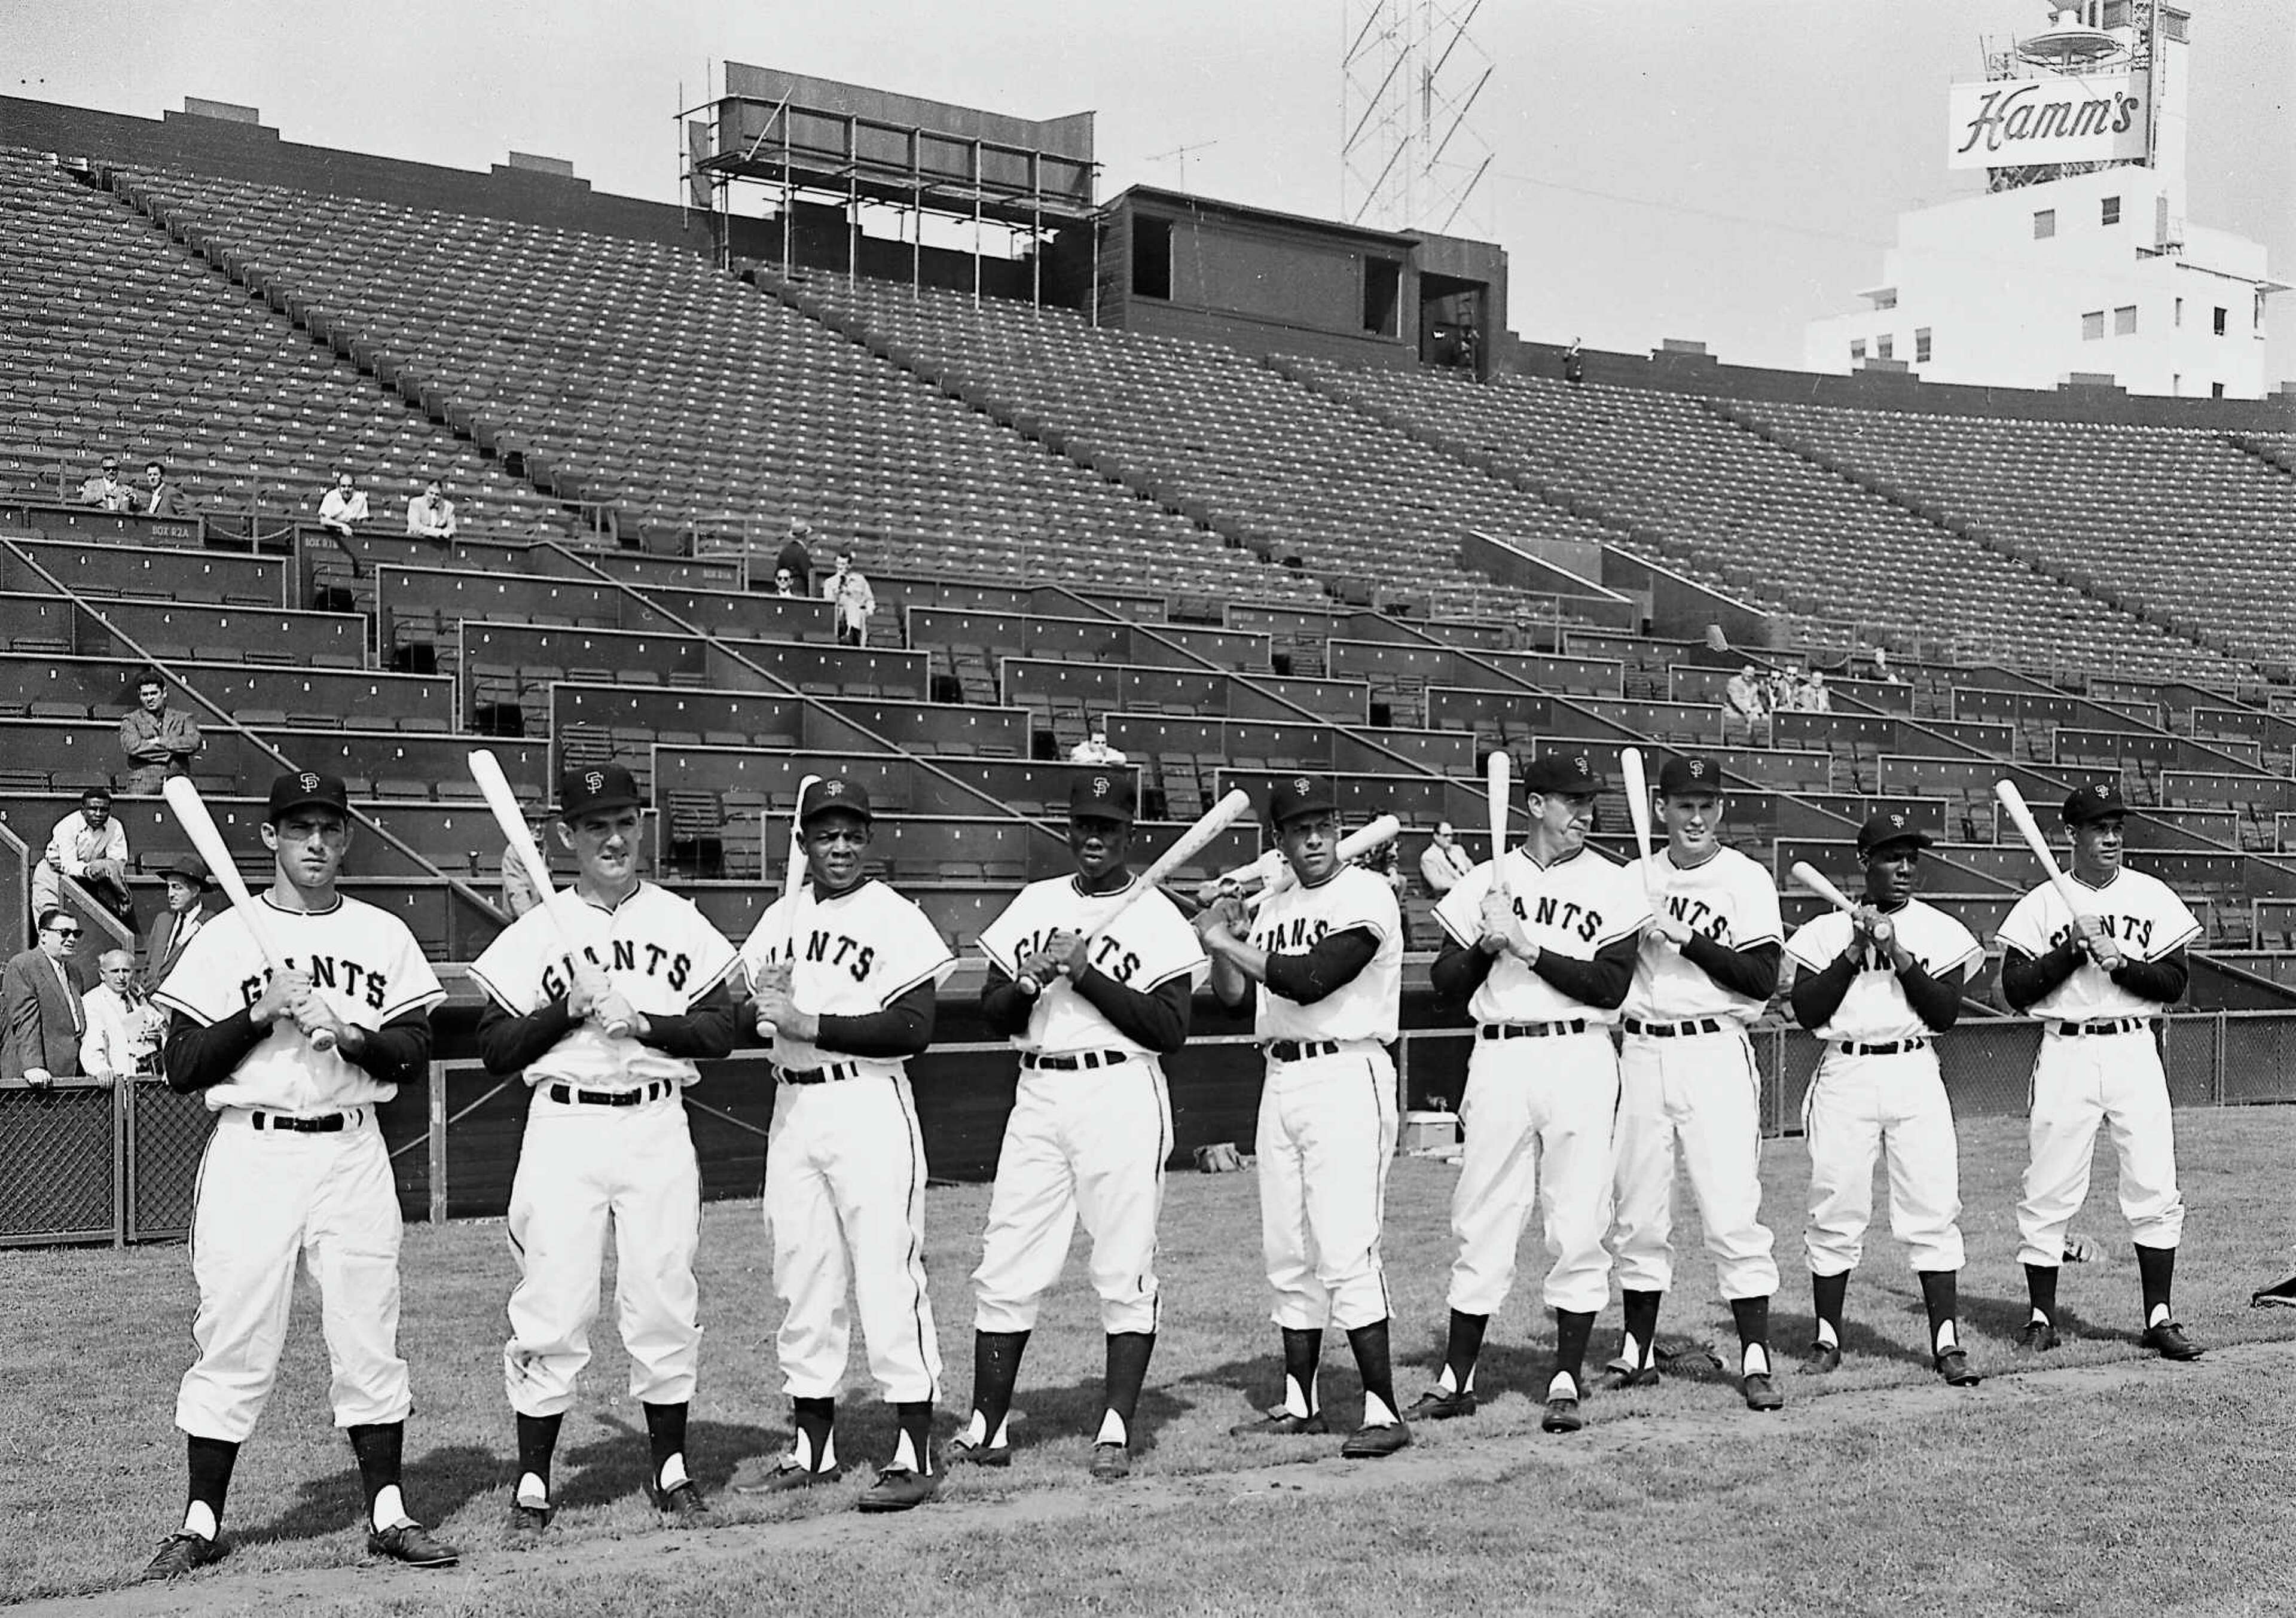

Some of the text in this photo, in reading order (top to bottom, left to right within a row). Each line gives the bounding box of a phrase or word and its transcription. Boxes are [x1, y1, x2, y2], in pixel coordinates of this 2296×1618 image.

[1958, 85, 2139, 152] Hamm's
[152, 525, 169, 536] BOX
[305, 538, 321, 548] BOX
[1689, 760, 1705, 779] SF
[300, 773, 320, 793] SF
[585, 771, 603, 795] SF
[1094, 777, 1110, 797] SF
[2050, 915, 2152, 949] GINTS
[1014, 927, 1140, 982] GITS
[240, 954, 387, 1010] GINTS
